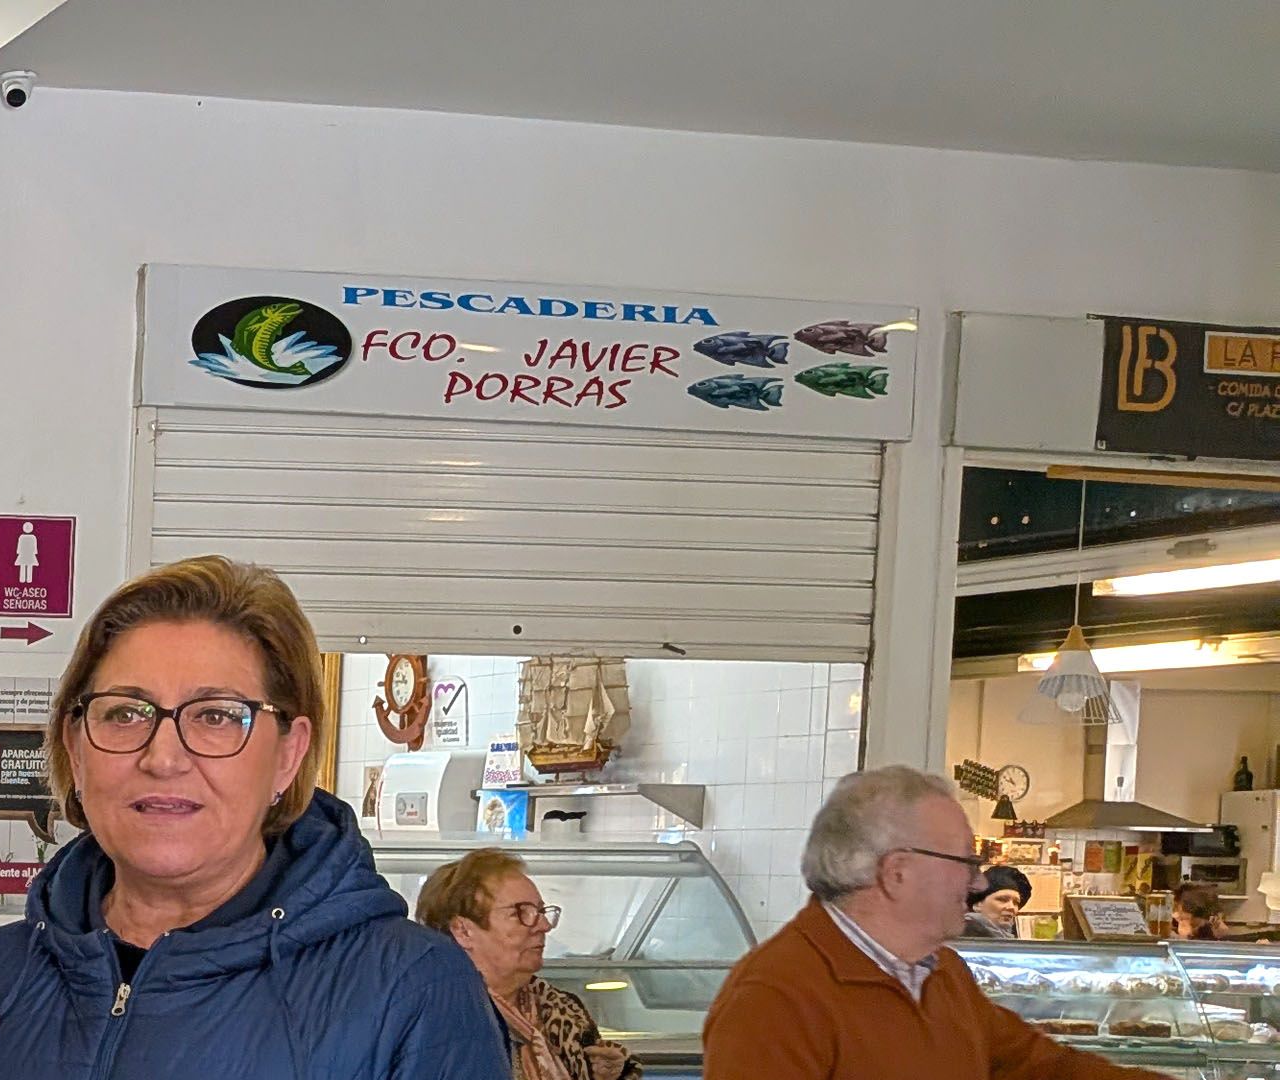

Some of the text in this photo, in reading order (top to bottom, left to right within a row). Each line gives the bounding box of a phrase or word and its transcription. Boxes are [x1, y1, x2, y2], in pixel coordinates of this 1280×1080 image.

[343, 286, 720, 326] PESCADERIA
[361, 329, 680, 378] FCO. JAVIER
[1224, 339, 1257, 367] LA
[443, 370, 633, 409] PORRAS
[1218, 381, 1271, 397] COMIDA
[4, 587, 47, 598] WC-ASEO
[3, 597, 47, 610] SEÑORAS
[1, 770, 17, 778] para
[21, 868, 31, 877] al
